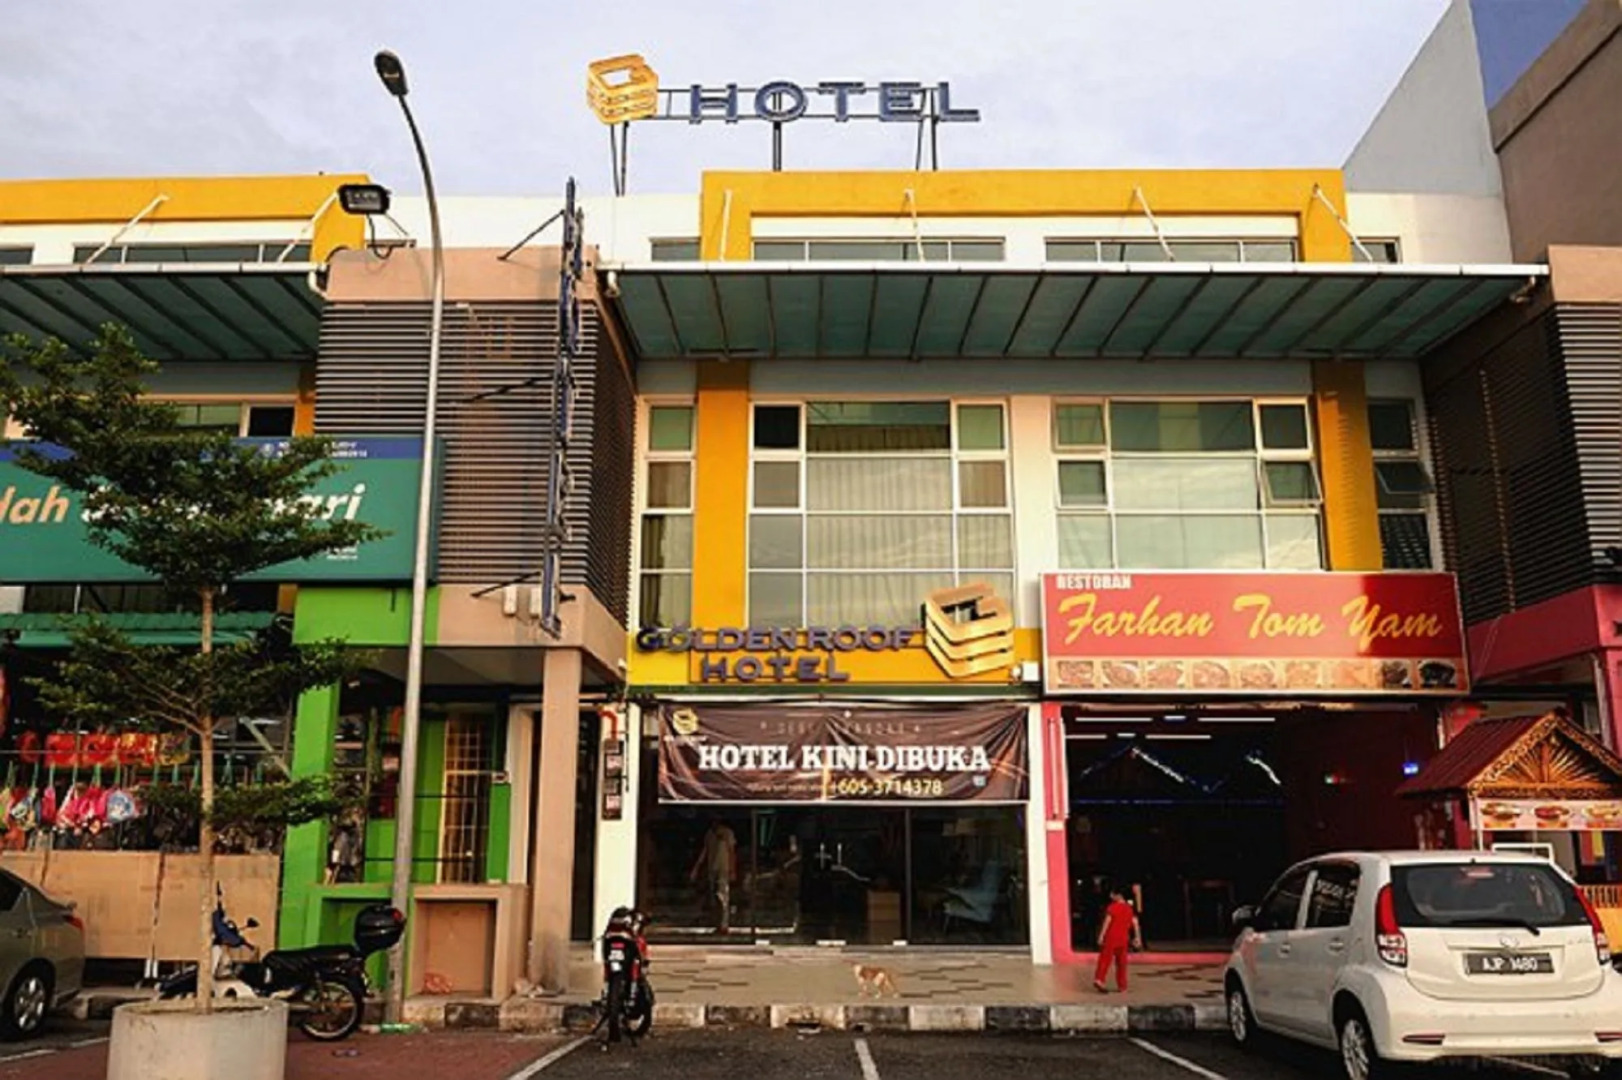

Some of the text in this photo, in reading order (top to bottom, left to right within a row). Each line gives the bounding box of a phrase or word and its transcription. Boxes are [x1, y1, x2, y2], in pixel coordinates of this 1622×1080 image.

[689, 81, 980, 124] HOTEL
[1056, 574, 1133, 590] RESTORAN
[1058, 592, 1443, 653] Farhan Tom Yam
[636, 625, 914, 654] GOLDEN ROOF
[699, 651, 850, 683] HOTEL
[698, 744, 795, 772] HOTEL
